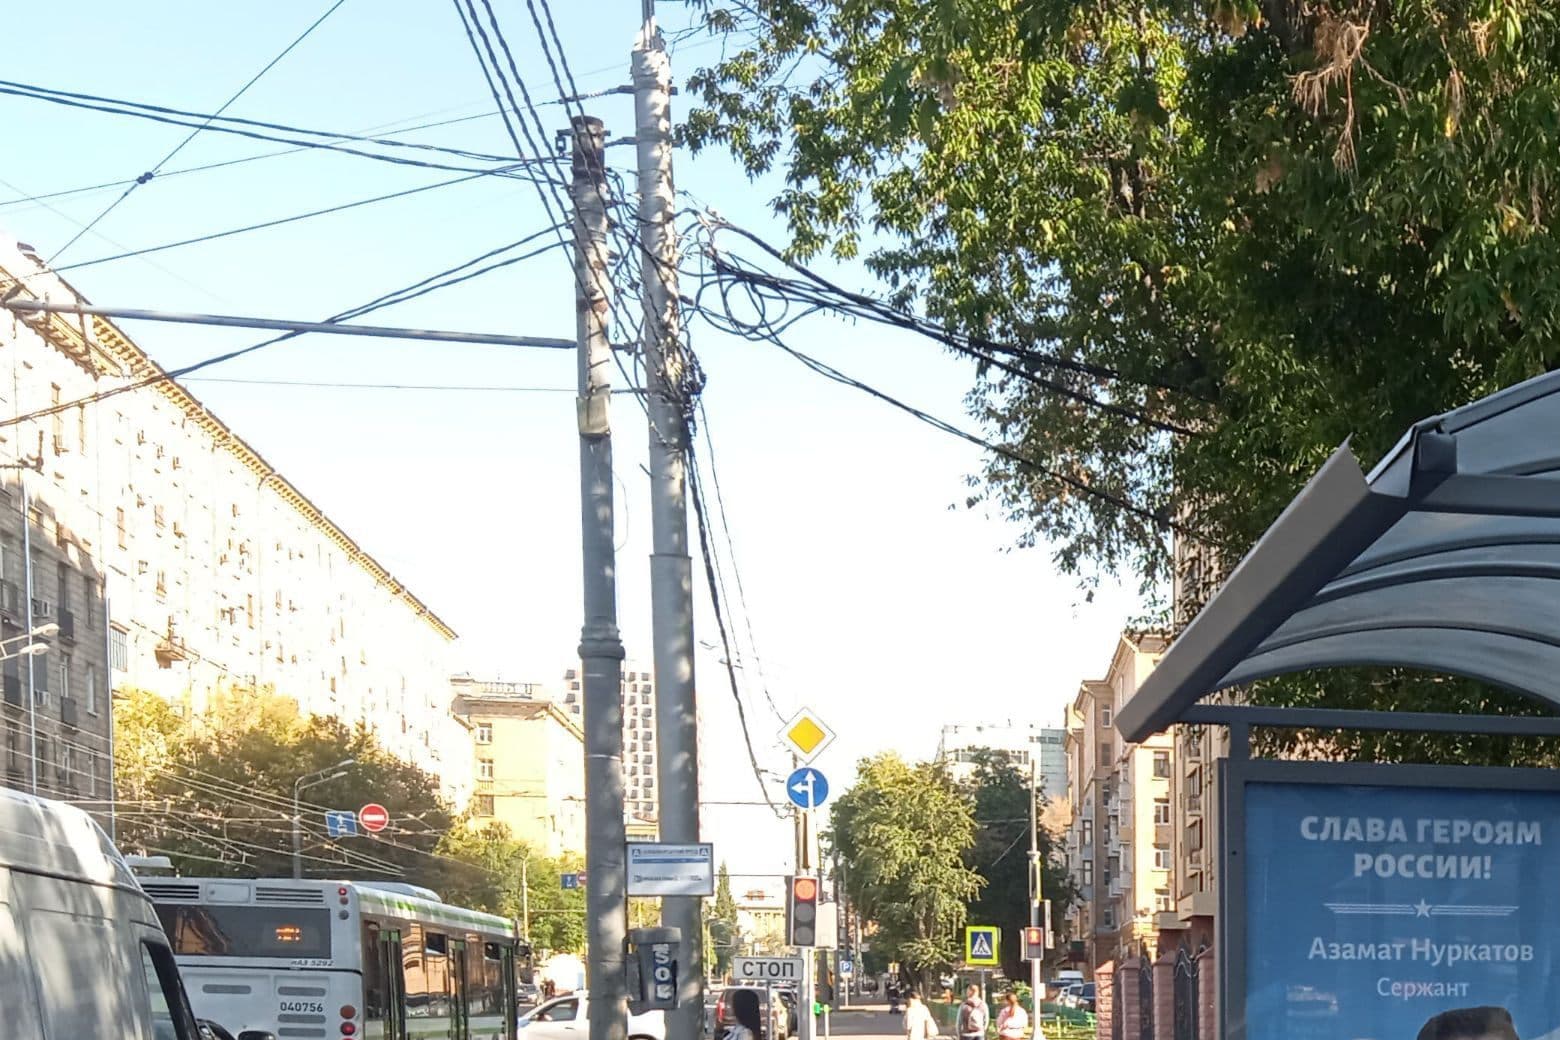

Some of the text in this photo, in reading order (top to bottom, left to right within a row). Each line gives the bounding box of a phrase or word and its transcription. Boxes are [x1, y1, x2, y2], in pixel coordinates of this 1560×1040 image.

[1301, 816, 1542, 845] СЛАВА ГЕРОЯМ
[1354, 853, 1492, 880] РОССИИ!
[1308, 936, 1534, 967] Азамат Нуркатов
[742, 961, 794, 977] СТОП
[1377, 976, 1469, 1000] Сержант
[280, 1002, 324, 1013] 040756
